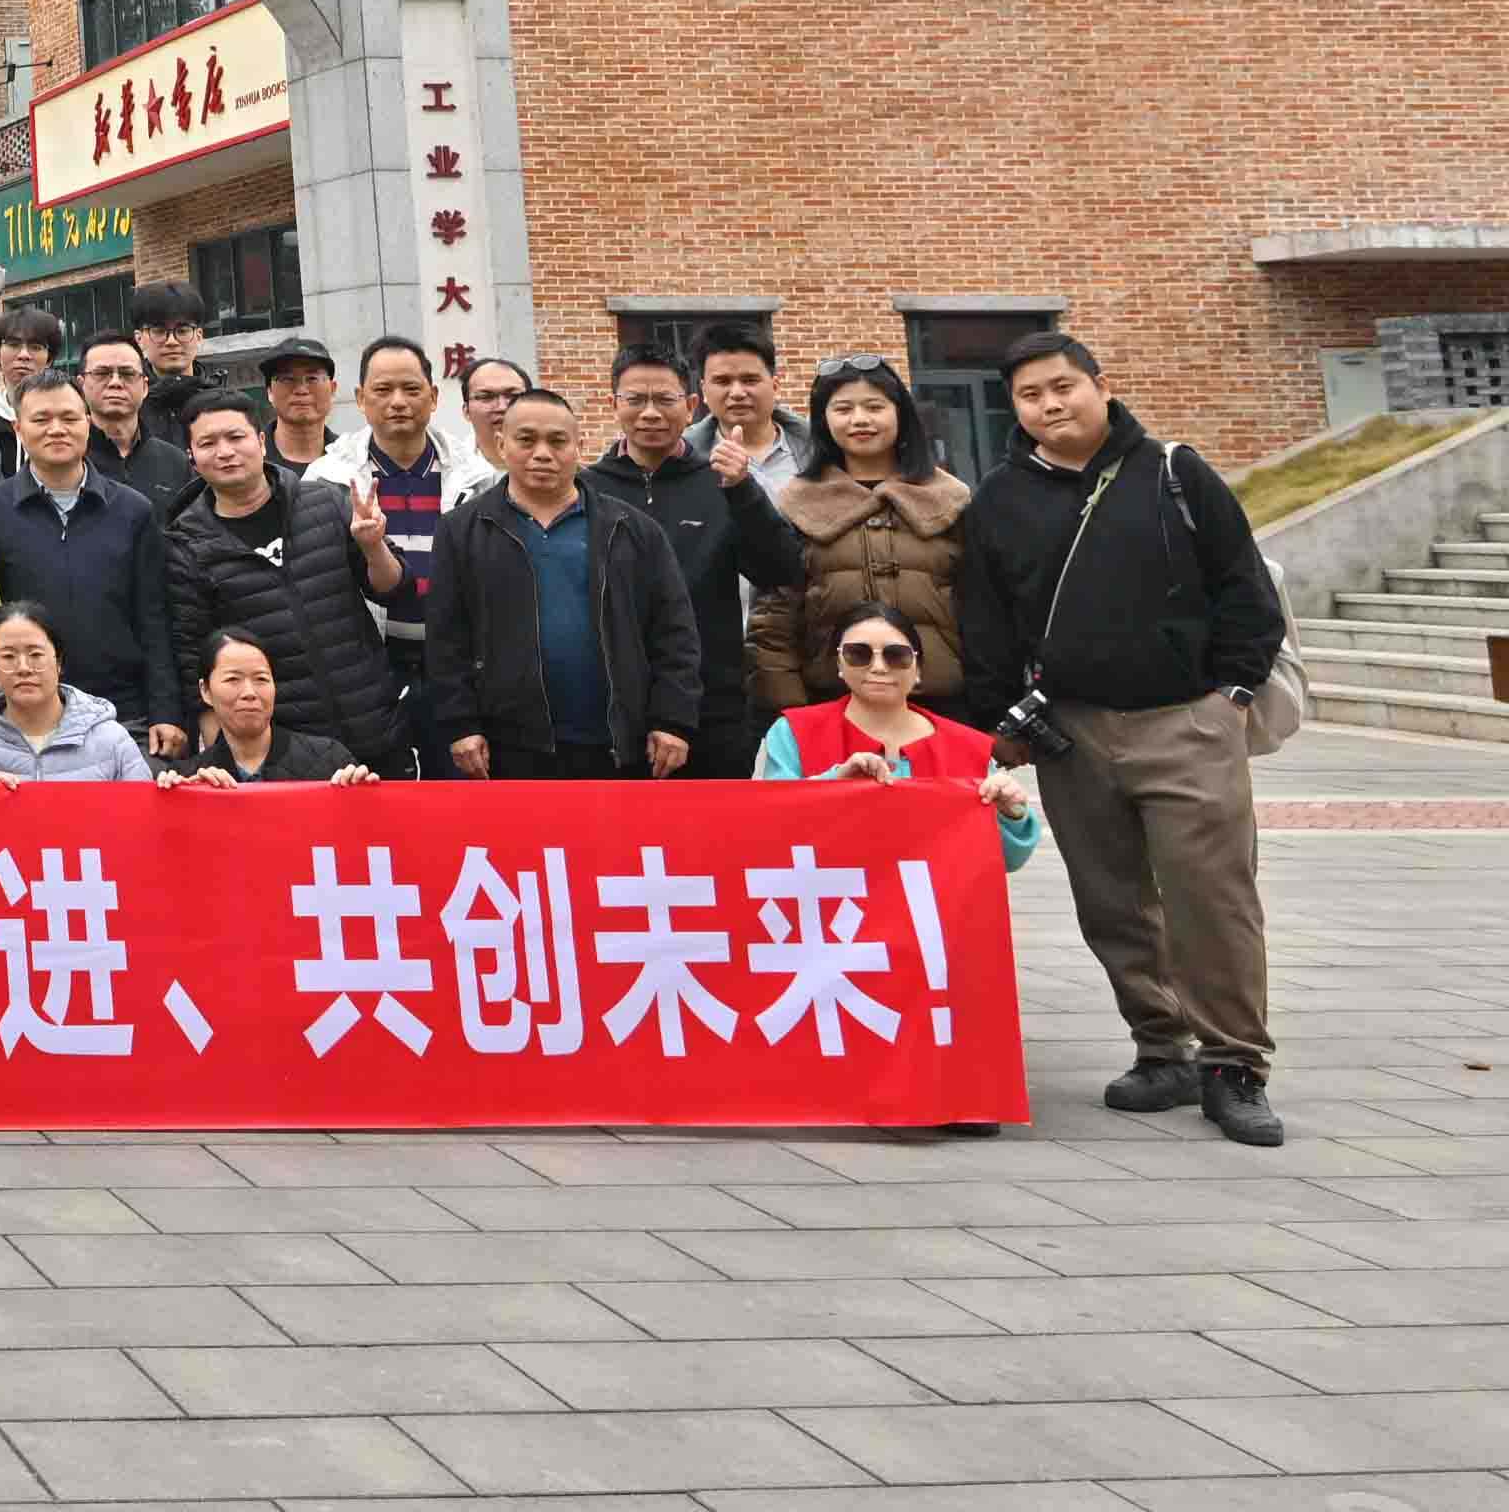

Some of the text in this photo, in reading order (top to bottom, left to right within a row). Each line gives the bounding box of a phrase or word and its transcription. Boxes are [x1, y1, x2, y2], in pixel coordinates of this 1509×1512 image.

[422, 82, 477, 379] 工业学大庆
